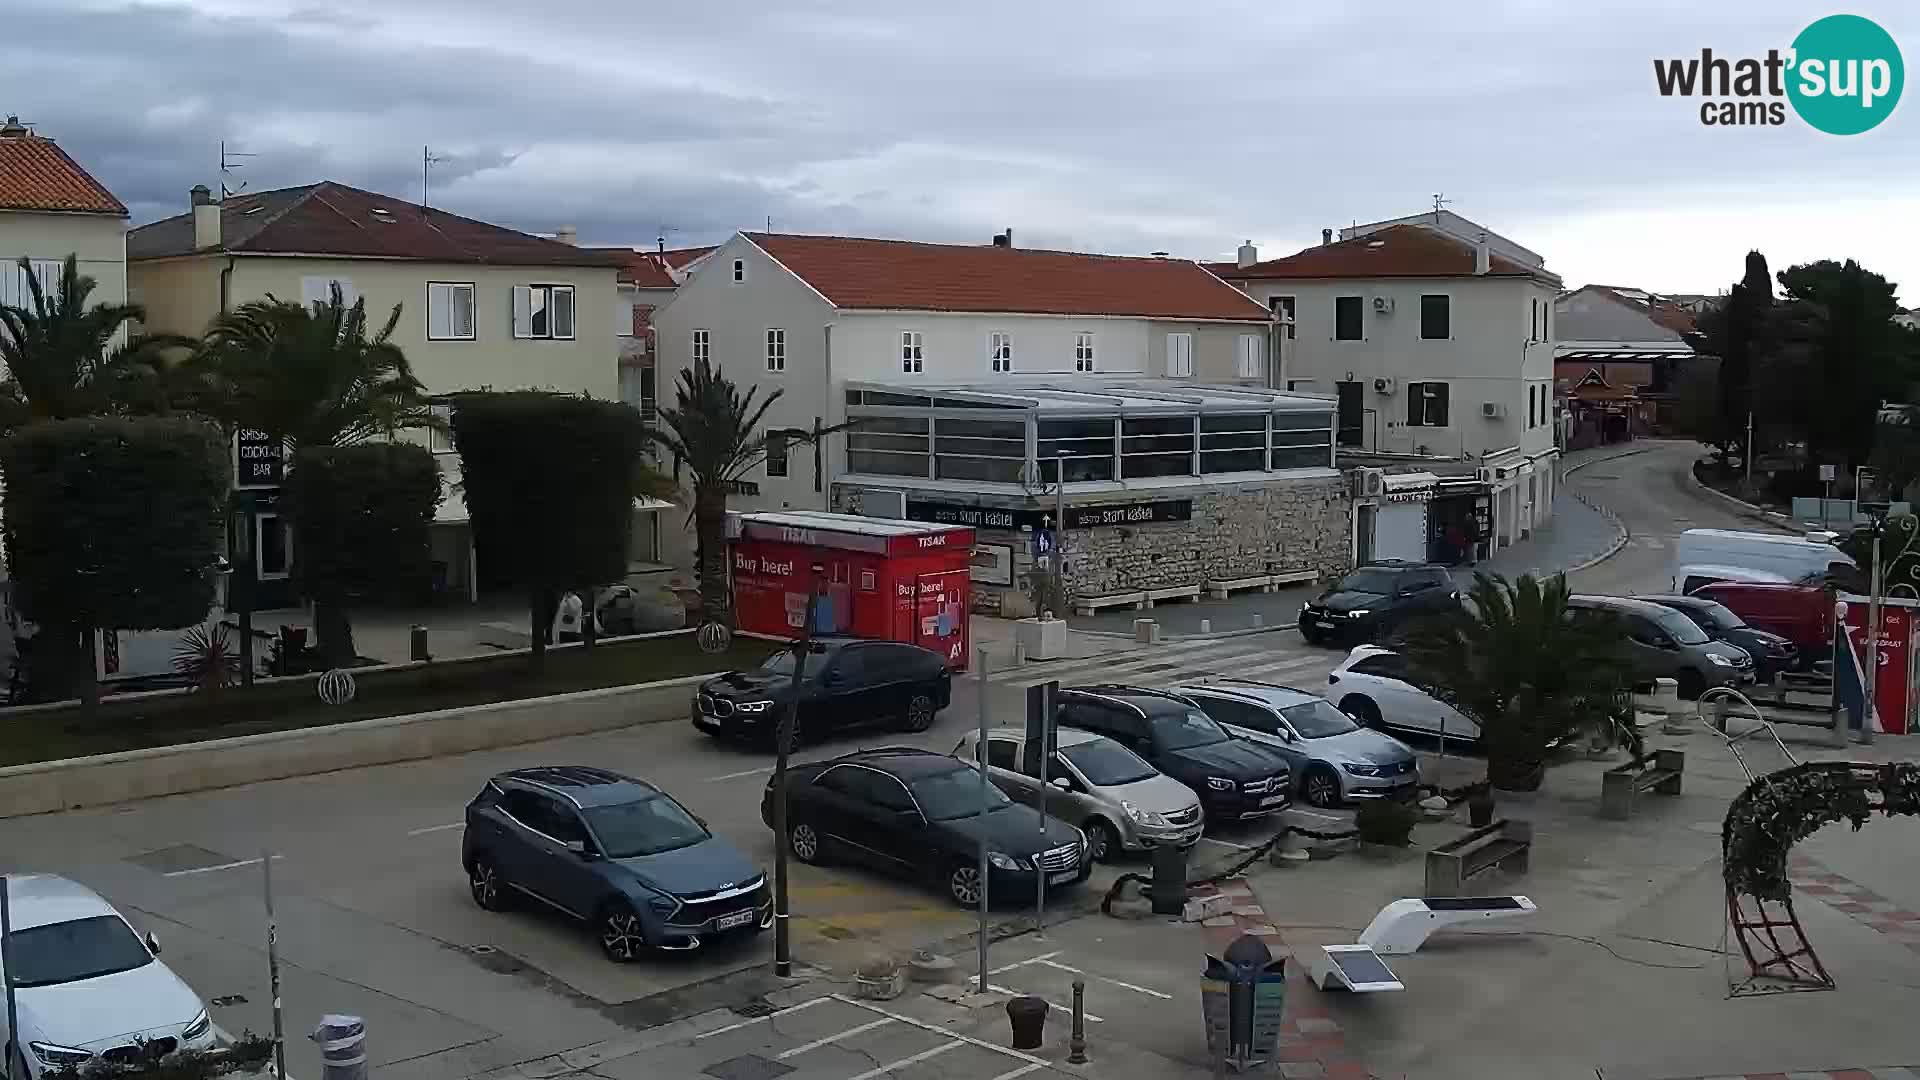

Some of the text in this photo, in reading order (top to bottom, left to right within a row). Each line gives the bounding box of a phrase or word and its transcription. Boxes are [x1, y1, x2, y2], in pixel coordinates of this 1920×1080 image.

[240, 428, 270, 441] SHISH
[253, 463, 271, 476] BAR
[918, 535, 946, 548] TISAK
[735, 552, 793, 577] Buy here!
[898, 578, 944, 597] Buy here!
